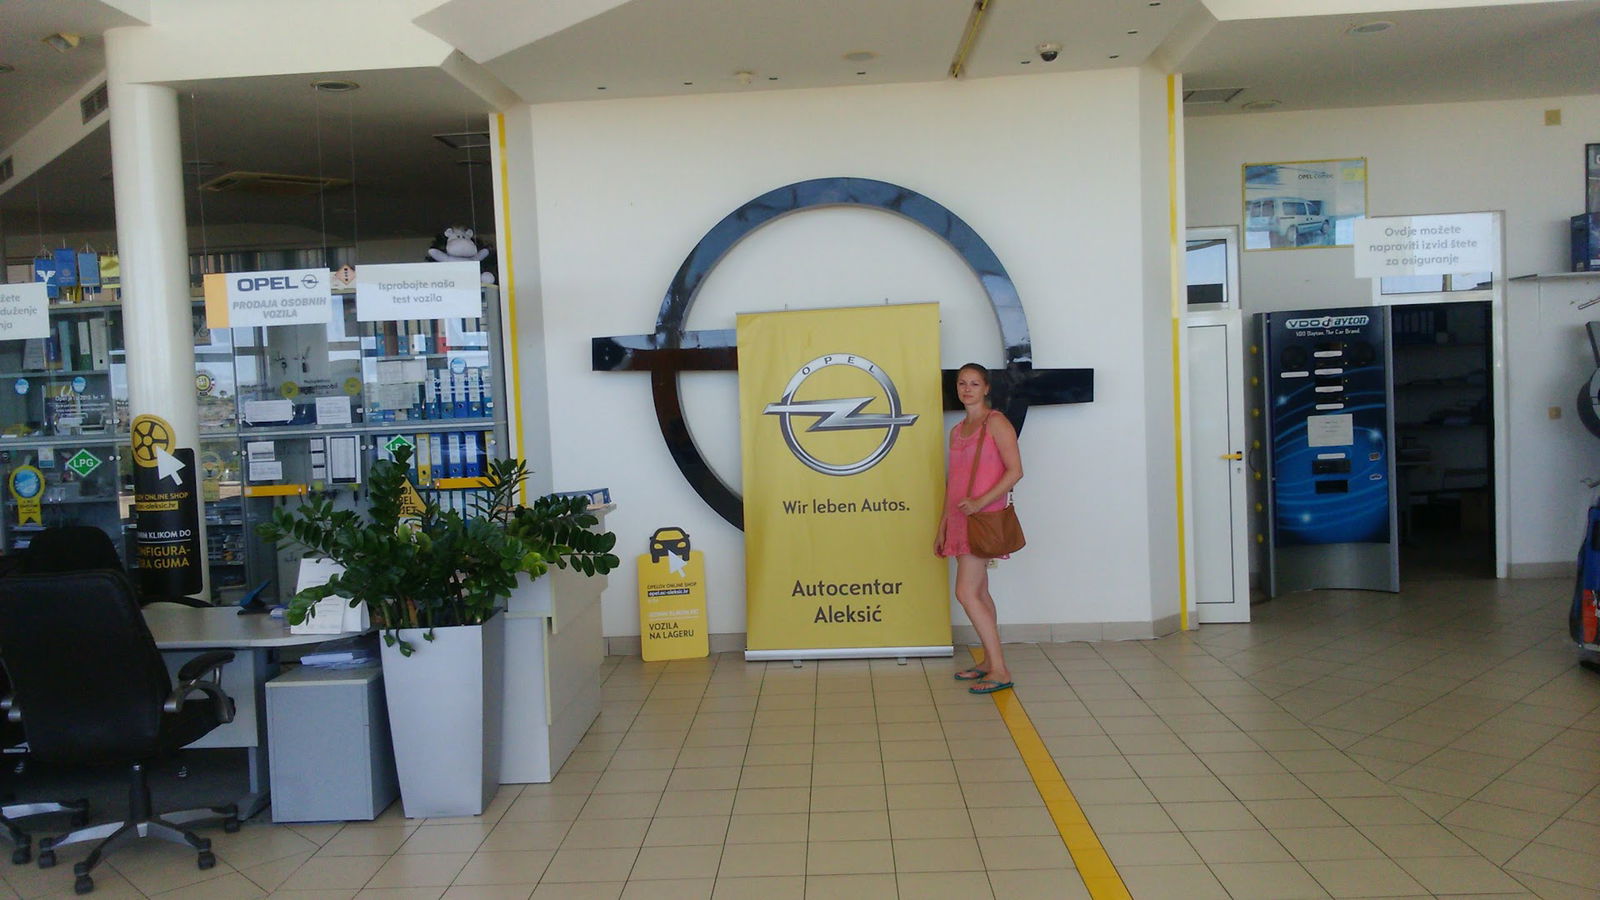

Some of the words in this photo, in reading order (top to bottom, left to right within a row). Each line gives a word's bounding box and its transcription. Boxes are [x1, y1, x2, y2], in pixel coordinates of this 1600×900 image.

[1384, 227, 1417, 238] Ovdje
[1420, 224, 1462, 235] možete
[1369, 240, 1419, 253] napraviti
[1422, 239, 1448, 250] izvid
[1450, 237, 1478, 249] štete
[1386, 257, 1399, 266] za
[1401, 255, 1459, 267] osiguranje
[237, 276, 298, 292] OPEL
[378, 280, 428, 291] Isprobajte
[430, 279, 455, 289] naša
[232, 298, 279, 310] PRODAJA
[280, 297, 326, 307] OSOBNIH
[392, 294, 411, 304] test
[413, 293, 443, 303] vozila
[262, 309, 298, 319] VOZILA
[801, 356, 876, 376] OPEL
[73, 458, 94, 468] LPG
[144, 493, 169, 501] ONLINE
[170, 491, 189, 500] SHOP
[783, 501, 808, 514] Wir
[813, 498, 856, 514] leben
[861, 498, 910, 513] Autos.
[148, 530, 178, 539] KLIKOM
[179, 529, 191, 538] DO
[154, 557, 190, 569] GUMA
[792, 579, 902, 597] Autocentar
[814, 604, 882, 624] Aleksić
[648, 621, 679, 631] VOZILA
[649, 632, 661, 640] NA
[662, 629, 694, 639] LAGERU
